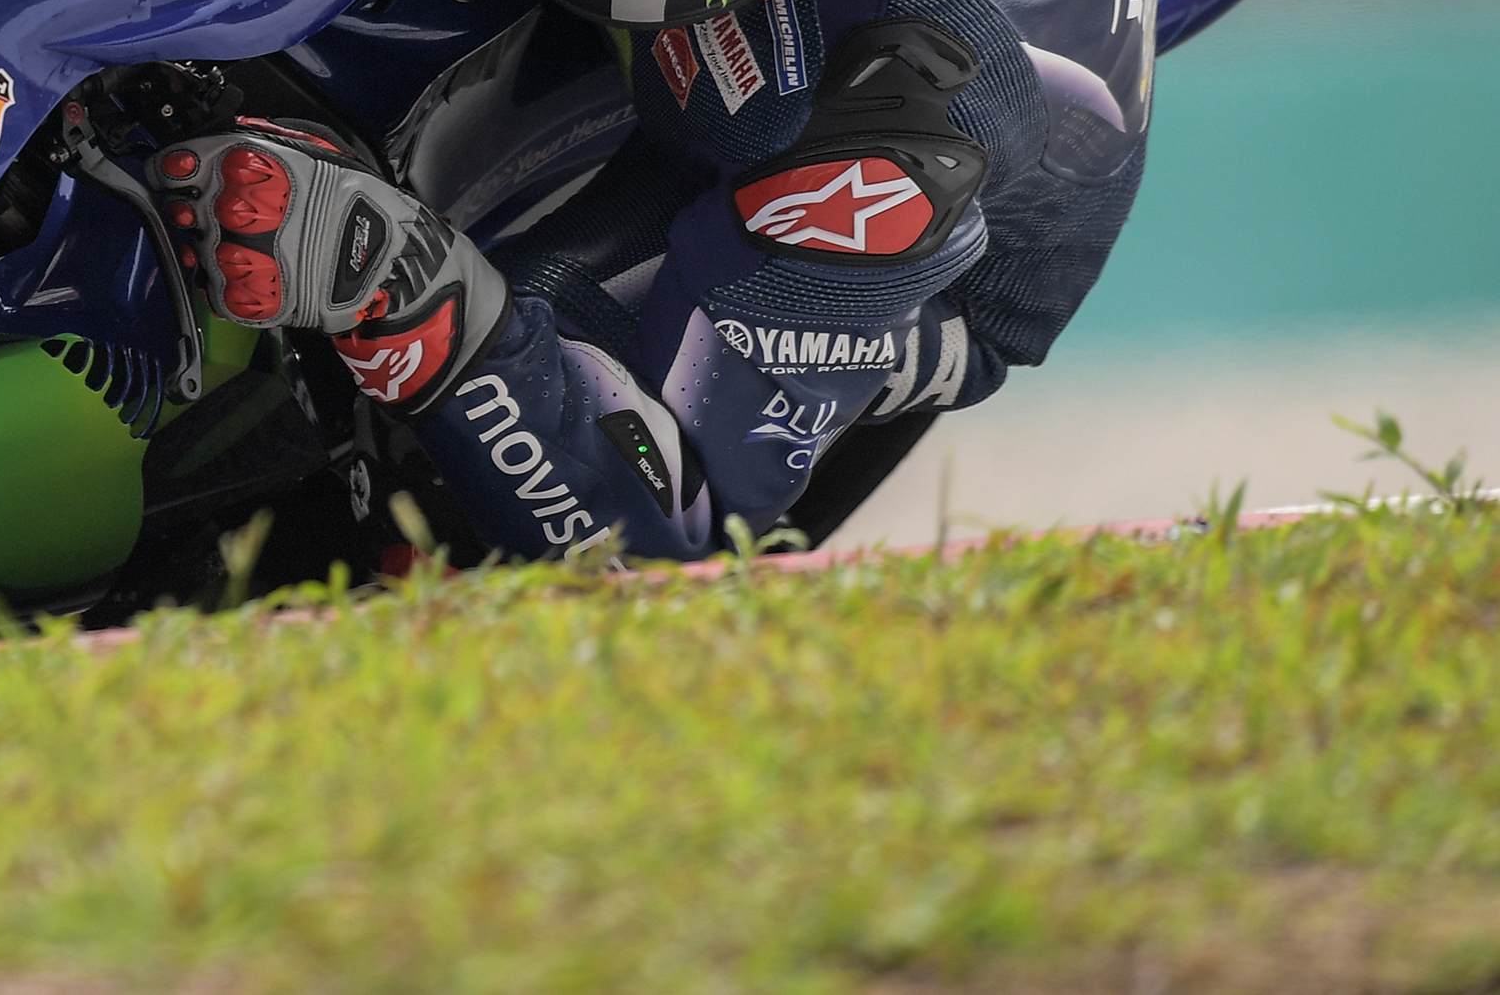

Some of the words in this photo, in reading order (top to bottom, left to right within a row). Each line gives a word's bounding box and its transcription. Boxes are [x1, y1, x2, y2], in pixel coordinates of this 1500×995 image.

[755, 326, 896, 365] YAMAHA
[758, 366, 808, 375] TORY
[817, 361, 895, 374] RACING
[455, 374, 612, 565] movist
